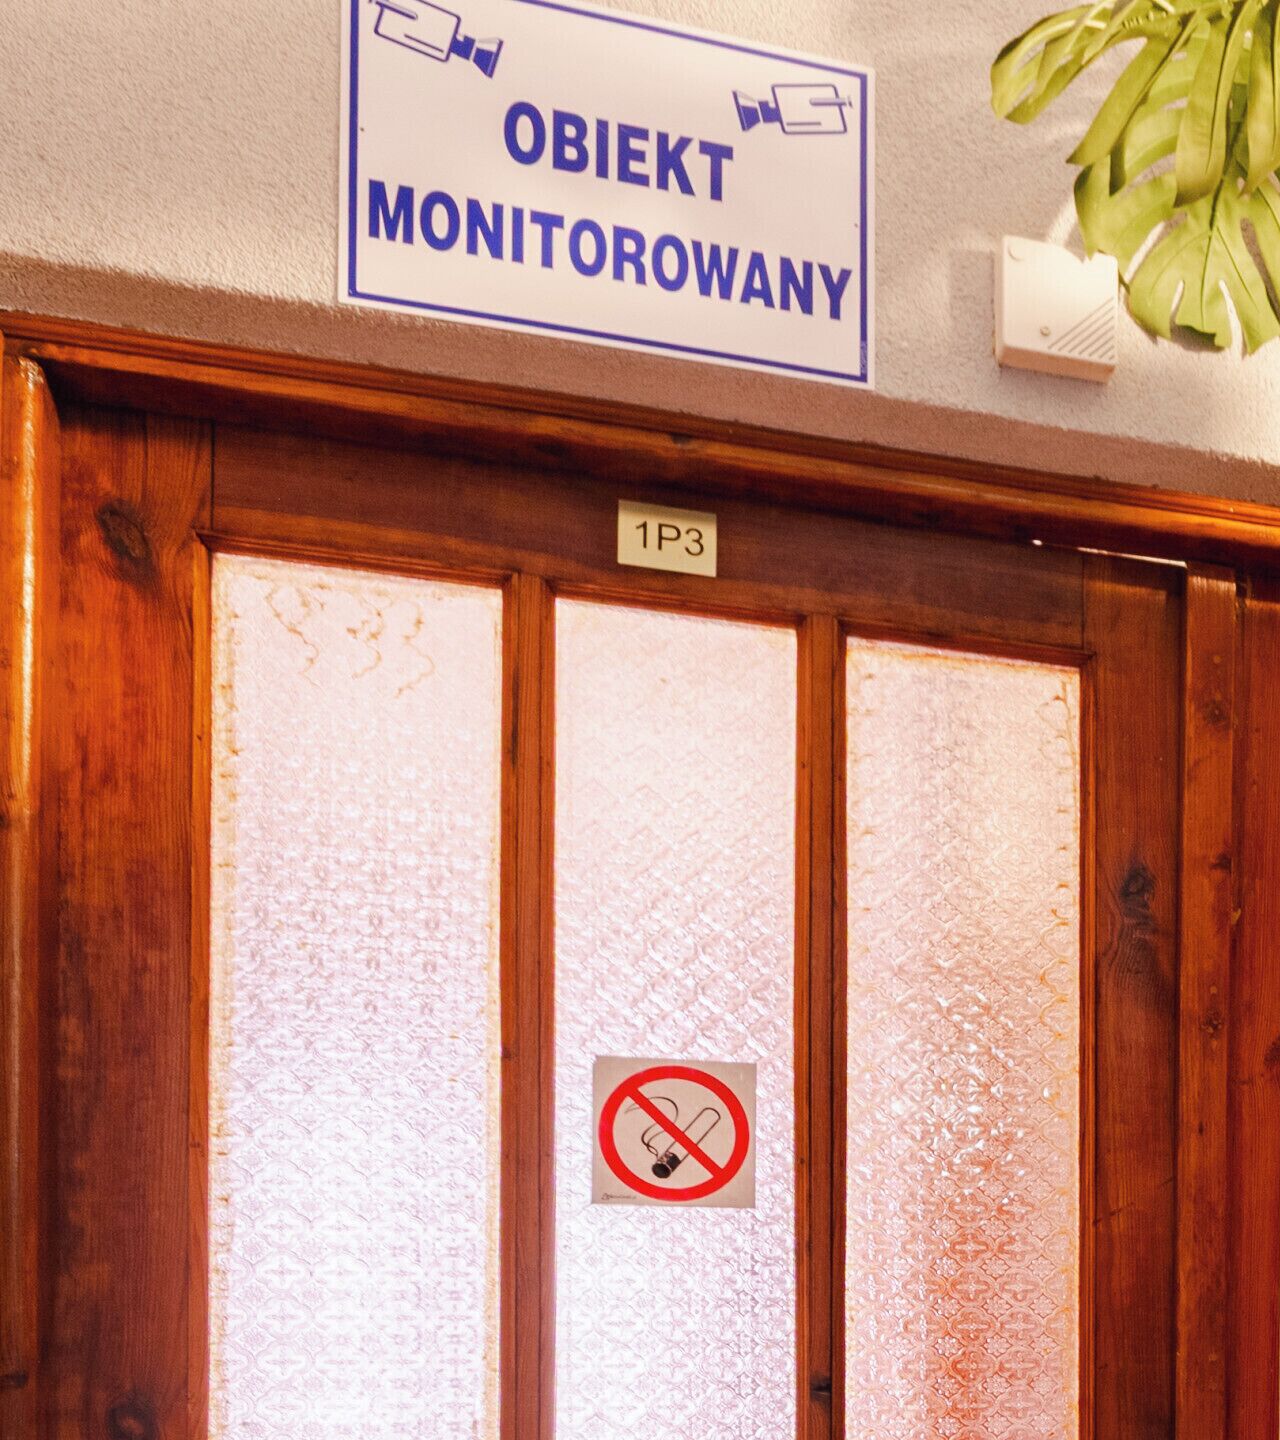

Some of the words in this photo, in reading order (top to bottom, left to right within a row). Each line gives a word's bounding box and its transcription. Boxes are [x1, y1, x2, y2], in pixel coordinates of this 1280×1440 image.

[503, 101, 734, 202] OBIEKT
[368, 180, 852, 321] MONITOROWANY
[636, 520, 704, 556] 1P3
